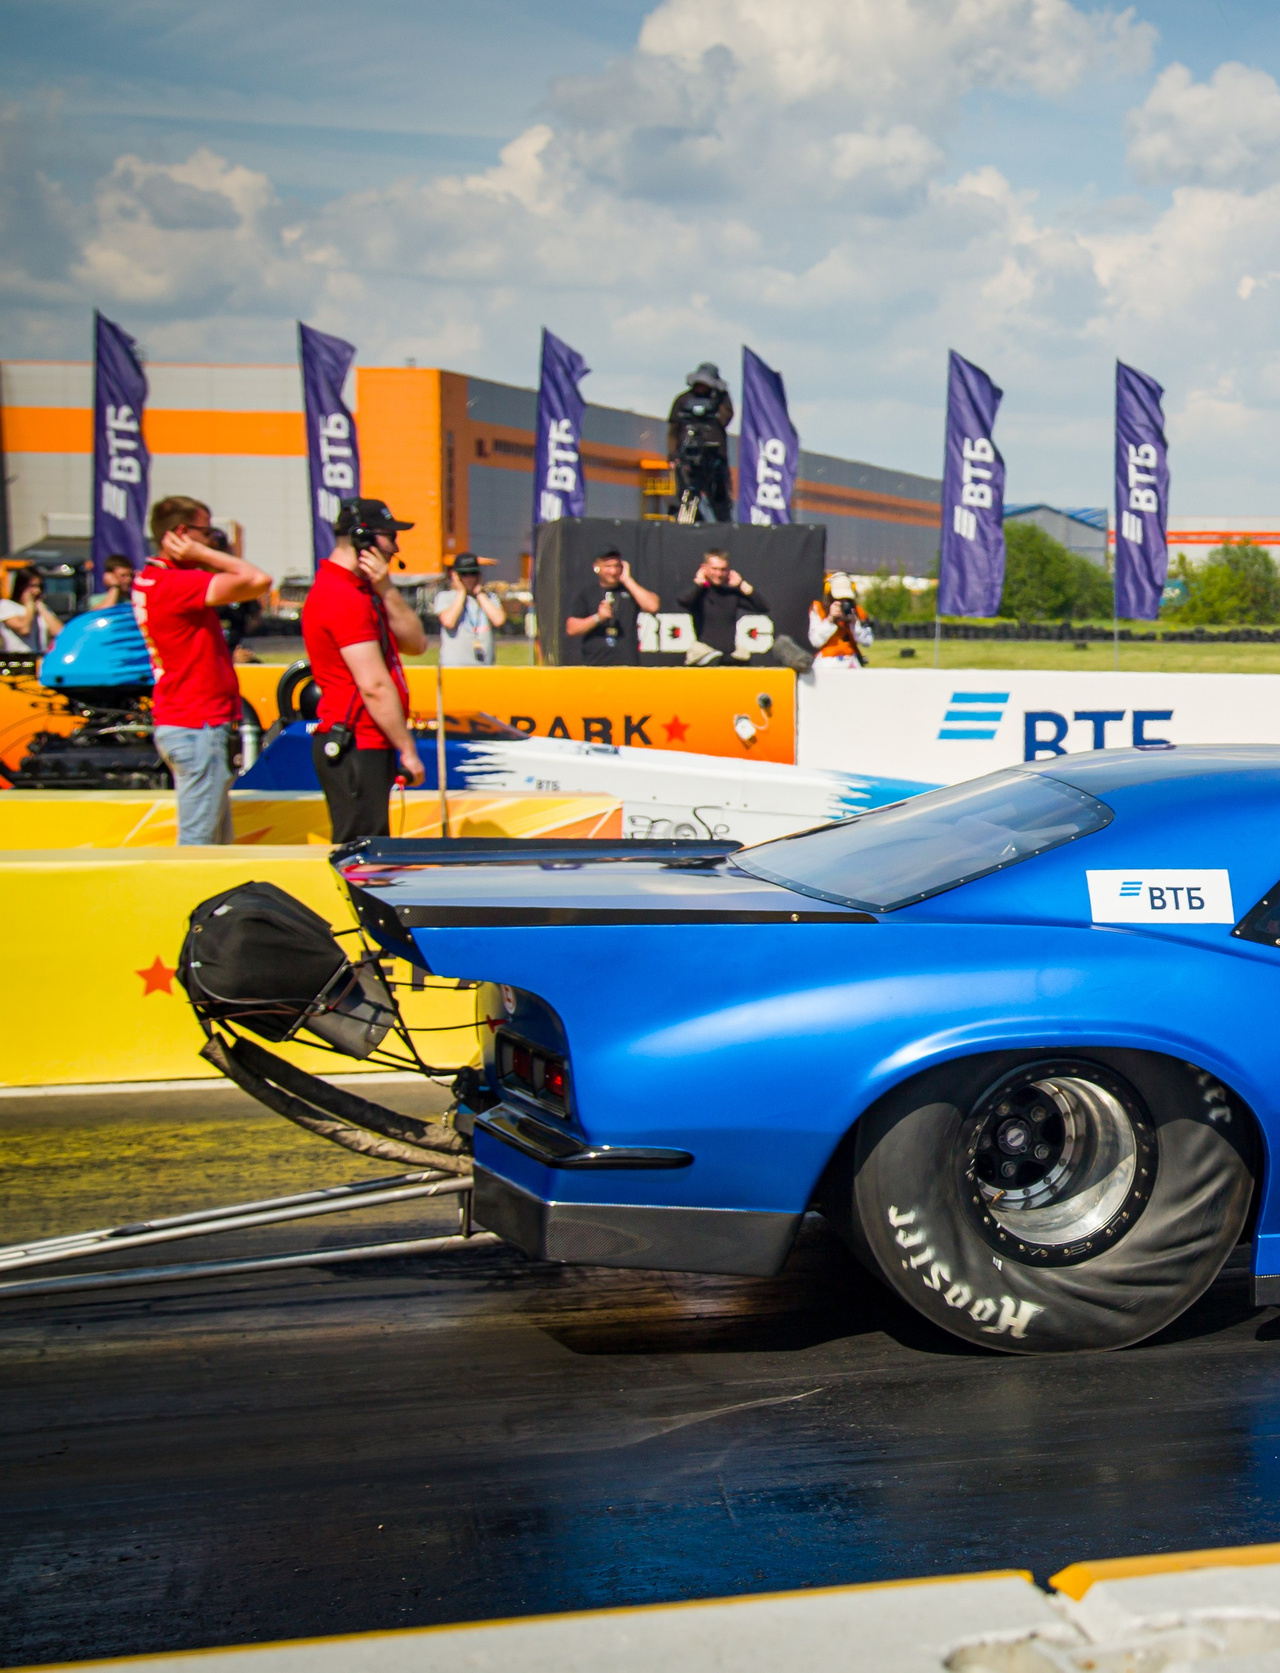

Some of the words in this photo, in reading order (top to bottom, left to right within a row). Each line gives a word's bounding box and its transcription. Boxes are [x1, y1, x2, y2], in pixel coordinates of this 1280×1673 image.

[106, 404, 141, 484] ВТБ
[319, 412, 354, 489] ВТБ
[546, 418, 579, 492] ВТБ
[757, 438, 786, 510] ВТБ
[962, 437, 995, 509] ВТБ
[1128, 443, 1158, 513] ВТБ
[1148, 886, 1205, 911] ВТБ
[888, 1204, 1046, 1339] Hoosier
